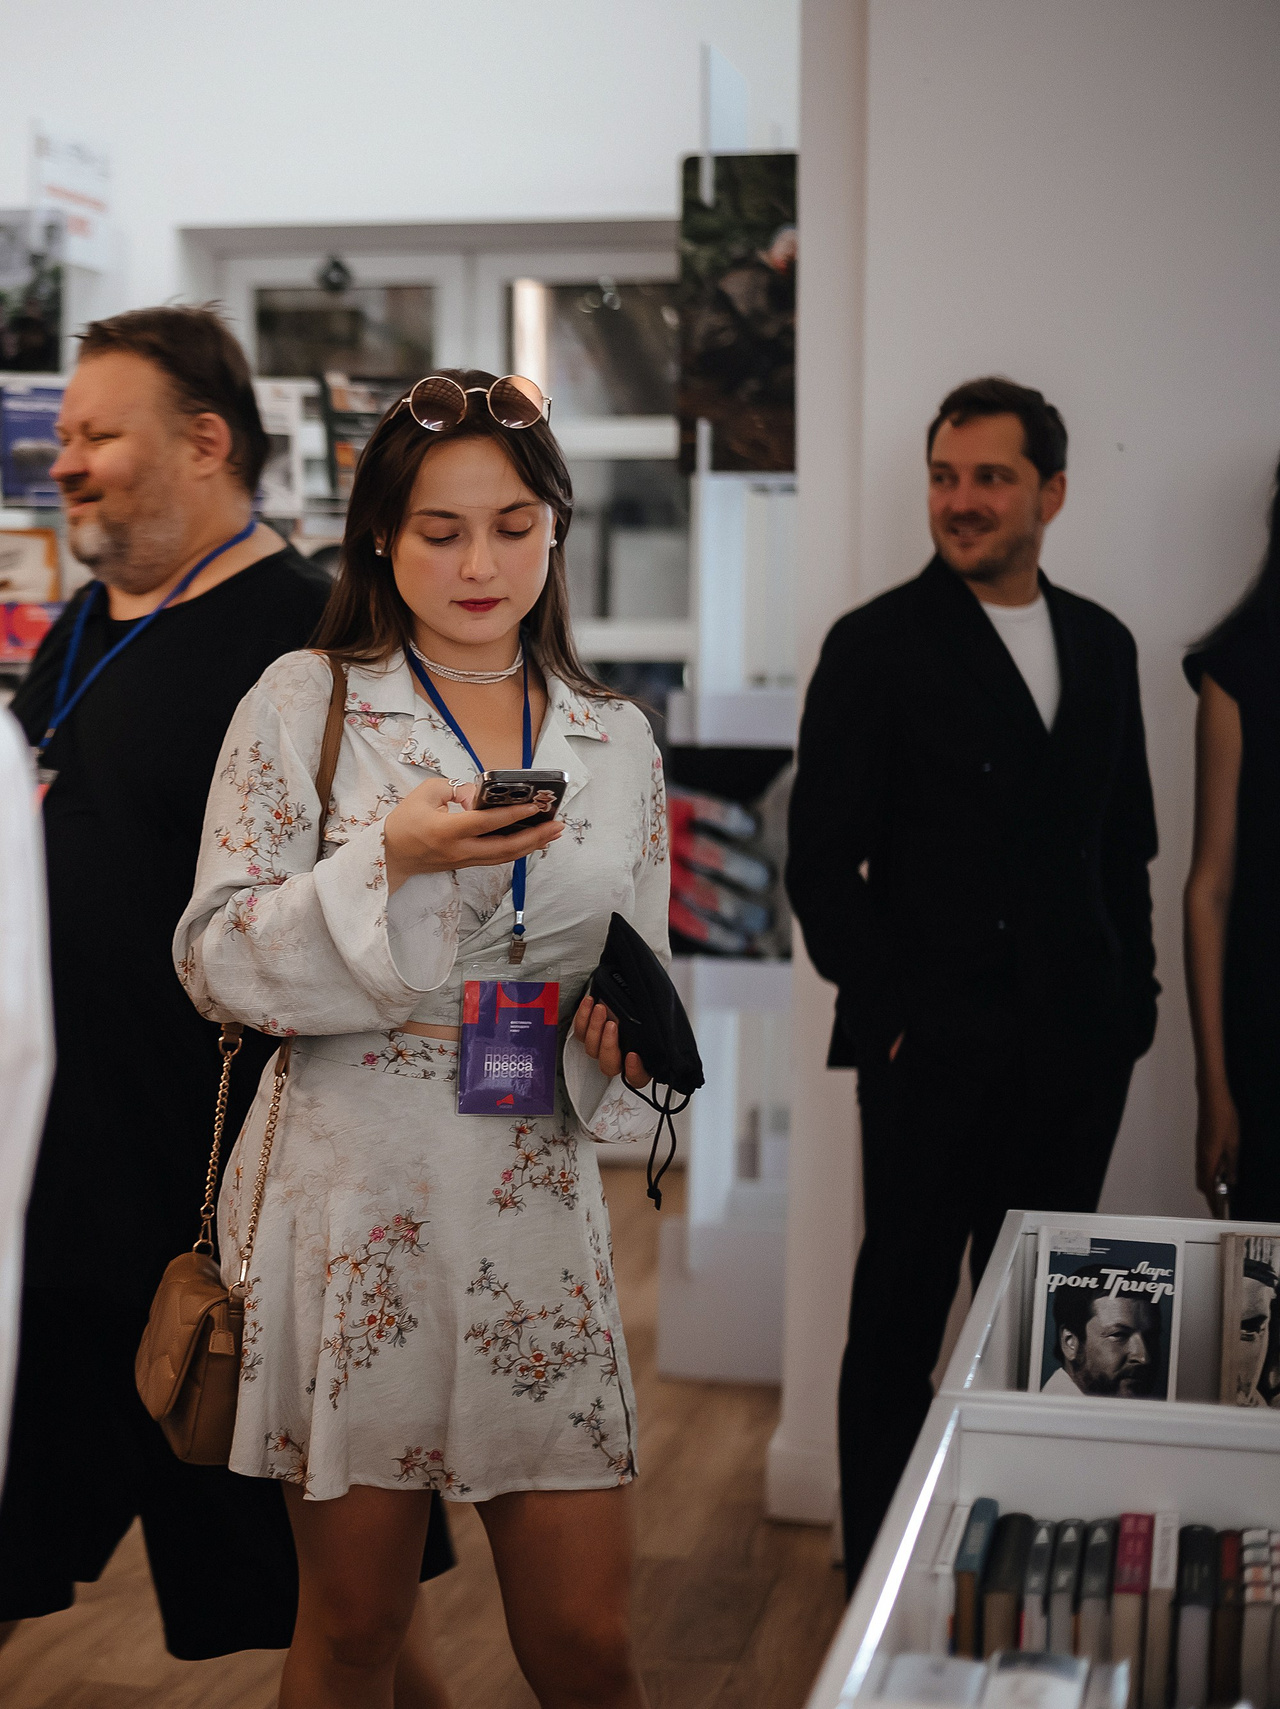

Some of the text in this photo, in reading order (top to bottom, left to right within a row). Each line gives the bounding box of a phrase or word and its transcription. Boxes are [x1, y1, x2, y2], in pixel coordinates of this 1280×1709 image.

[484, 1061, 534, 1074] пресса
[1130, 1261, 1174, 1281] Ларс
[1046, 1268, 1175, 1304] фон Триер
